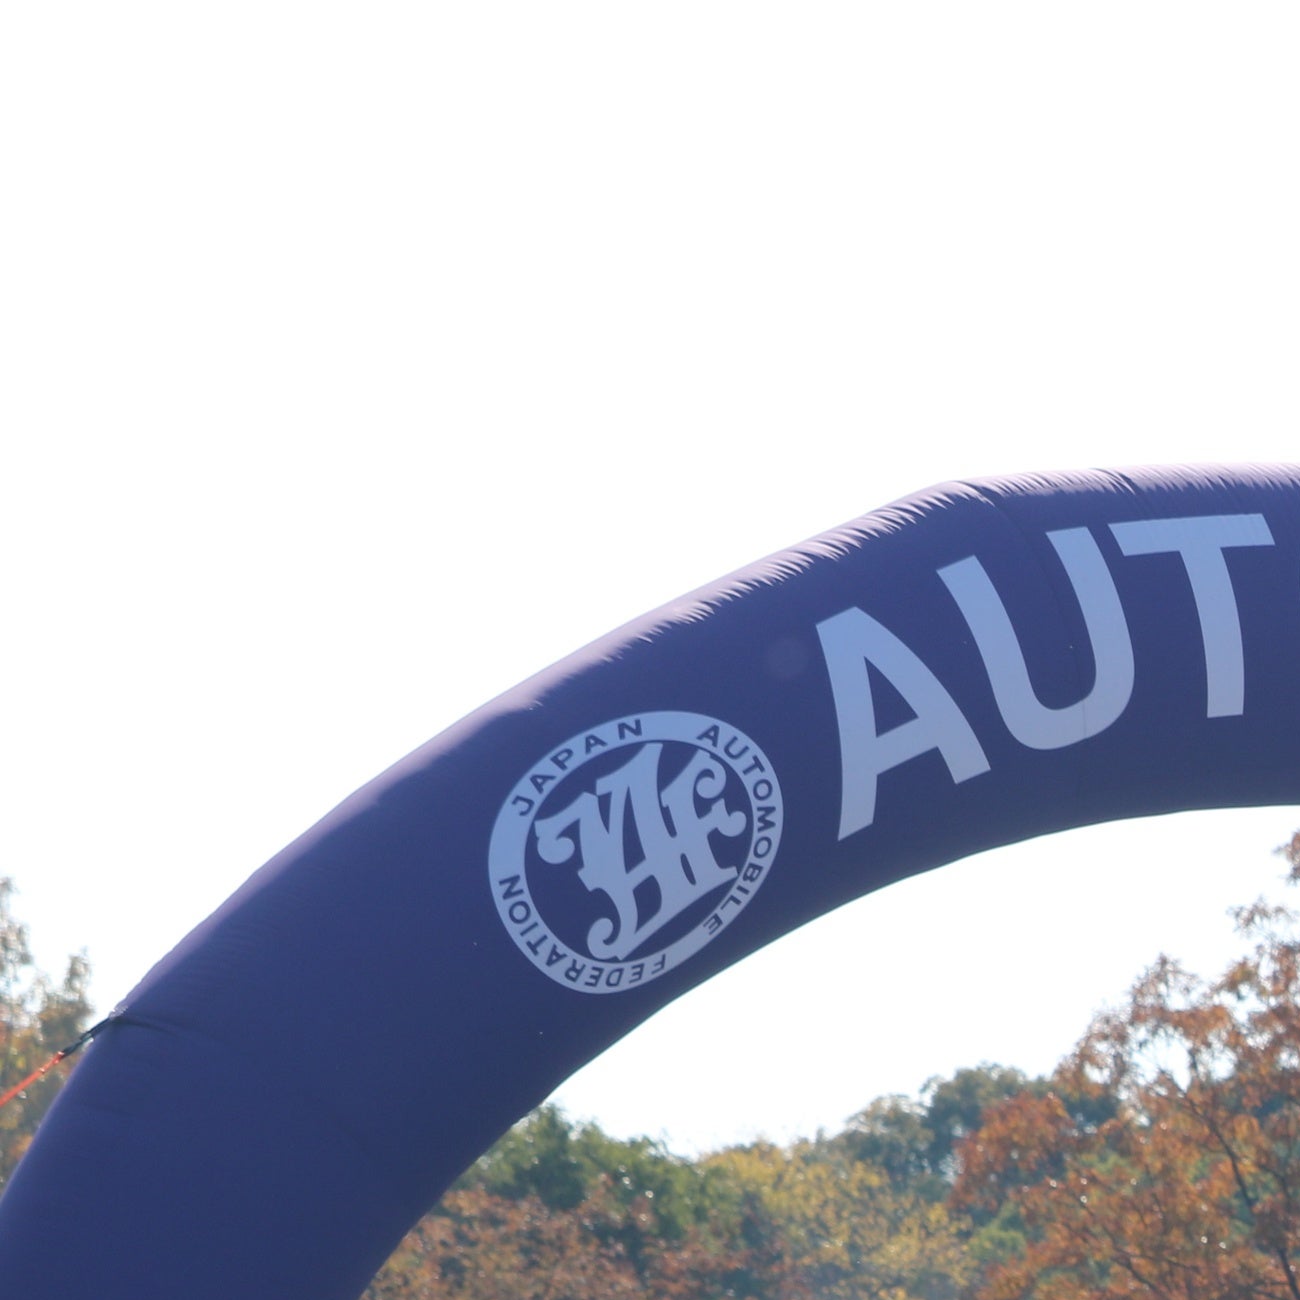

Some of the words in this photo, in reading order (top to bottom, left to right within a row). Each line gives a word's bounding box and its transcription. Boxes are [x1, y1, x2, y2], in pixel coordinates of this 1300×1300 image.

[511, 719, 643, 816] JAPAN
[696, 724, 777, 936] AUTOMOBILE
[499, 875, 666, 987] FEDERATION
